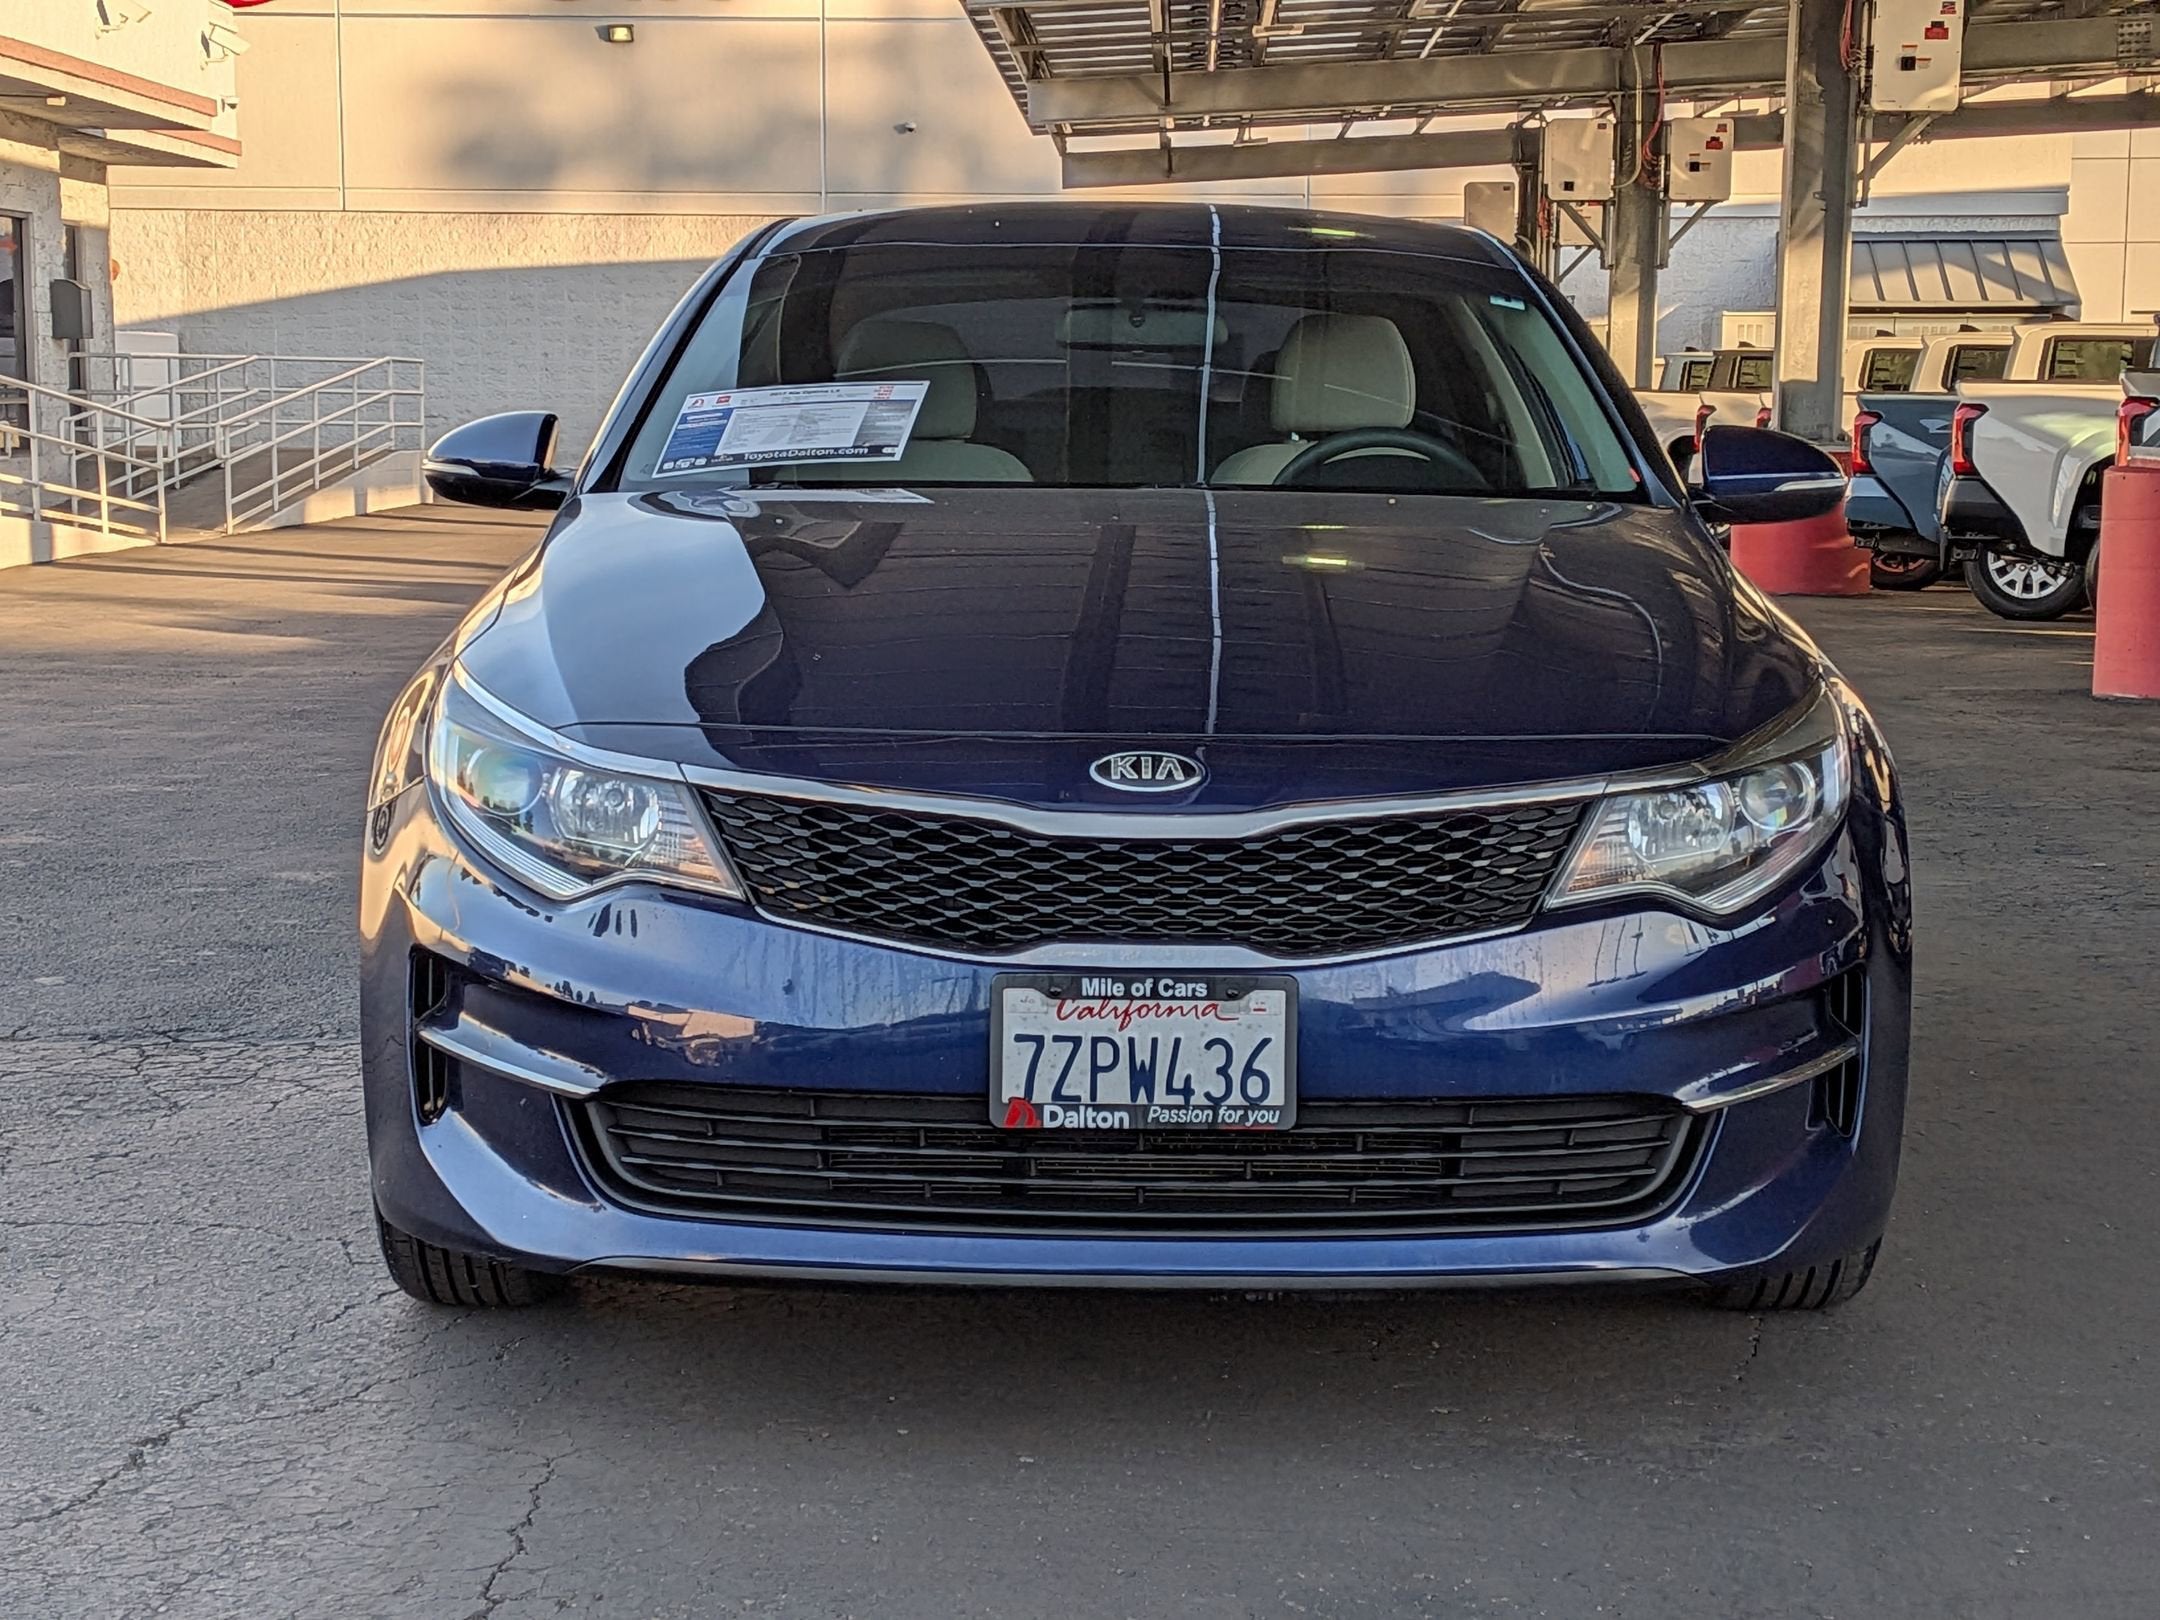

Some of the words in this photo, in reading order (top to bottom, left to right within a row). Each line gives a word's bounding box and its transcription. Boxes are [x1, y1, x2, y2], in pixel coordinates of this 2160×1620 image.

[743, 446, 869, 461] ToyotaDalton.com
[1110, 756, 1185, 781] KIA
[1082, 977, 1124, 997] Mile
[1130, 977, 1153, 997] of
[1158, 978, 1208, 998] Cars
[1056, 998, 1239, 1032] California
[1013, 1033, 1272, 1105] 7ZPW436
[1043, 1104, 1130, 1129] Dalton
[1147, 1106, 1213, 1124] Passion
[1217, 1106, 1245, 1124] for
[1245, 1109, 1281, 1127] you
